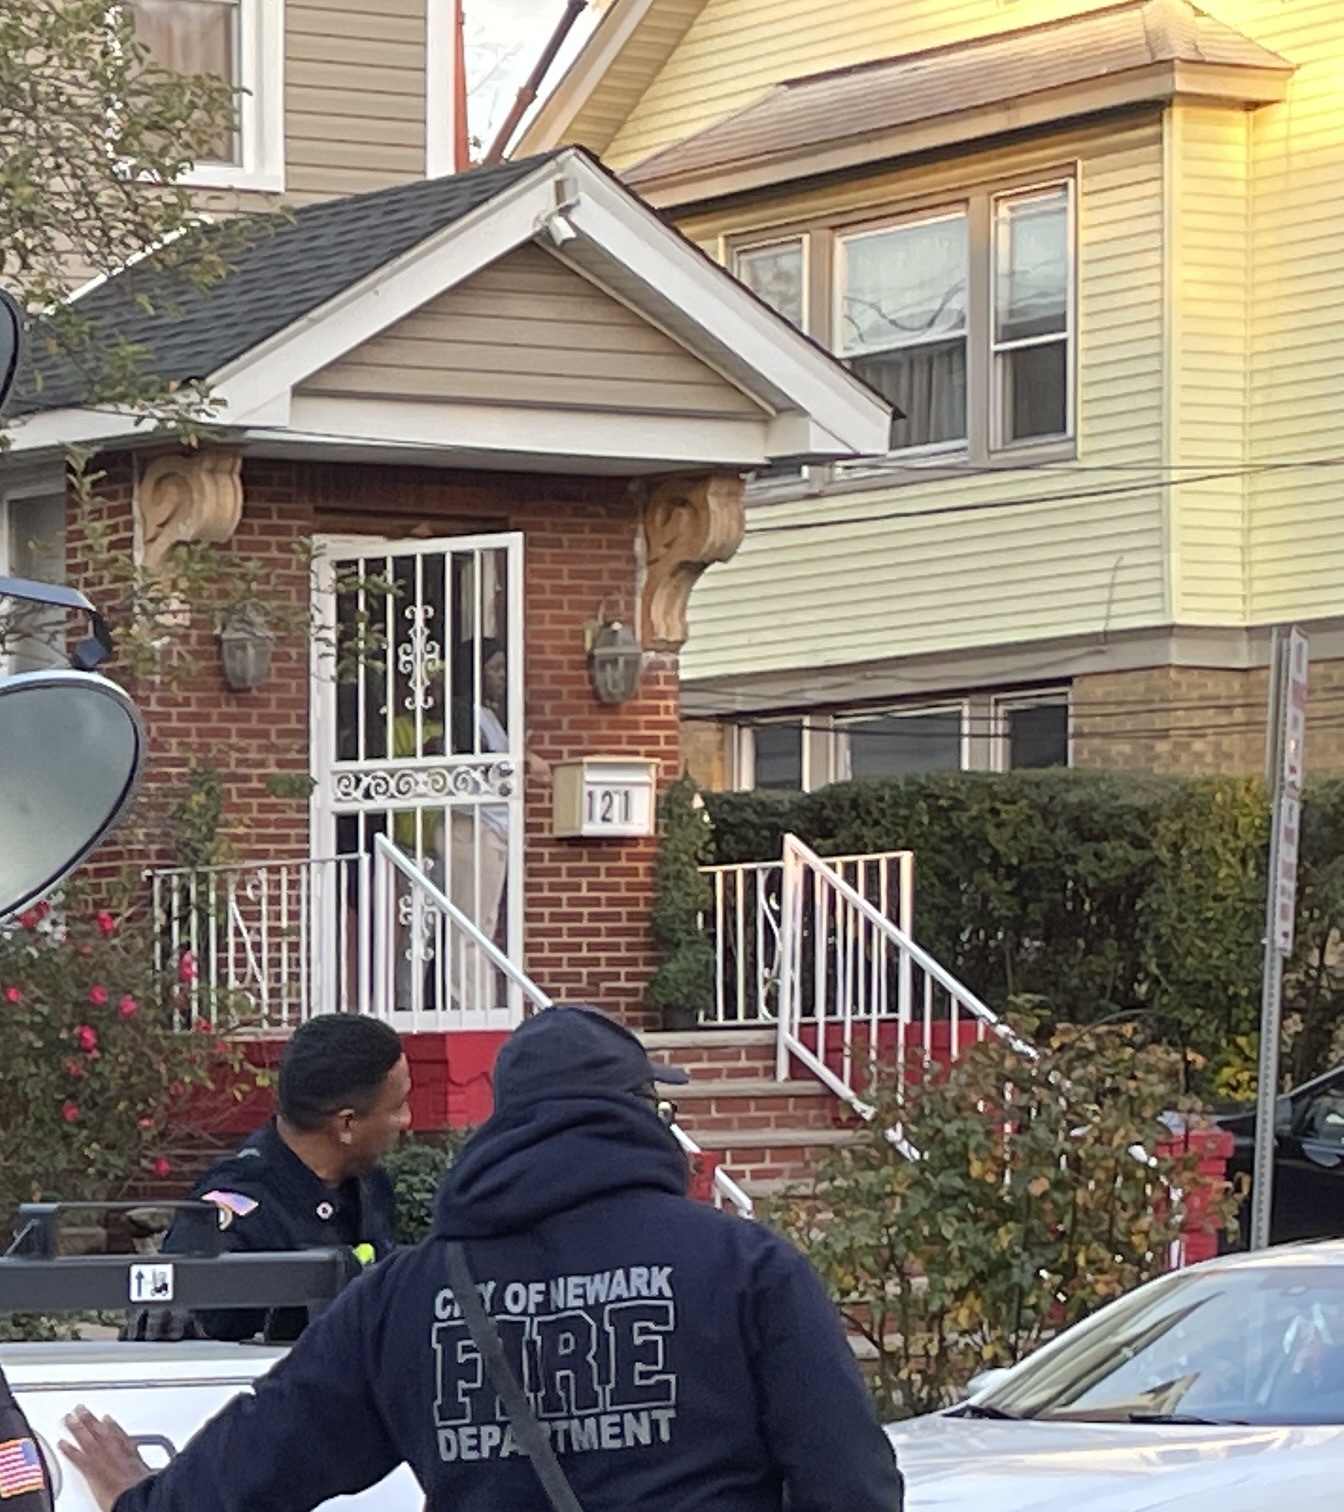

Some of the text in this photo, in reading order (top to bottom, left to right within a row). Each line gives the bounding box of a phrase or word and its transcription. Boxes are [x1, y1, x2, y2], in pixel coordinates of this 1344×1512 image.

[587, 789, 630, 823] 121
[434, 1265, 674, 1320] CY OF NEWARK
[431, 1299, 677, 1427] FIRE
